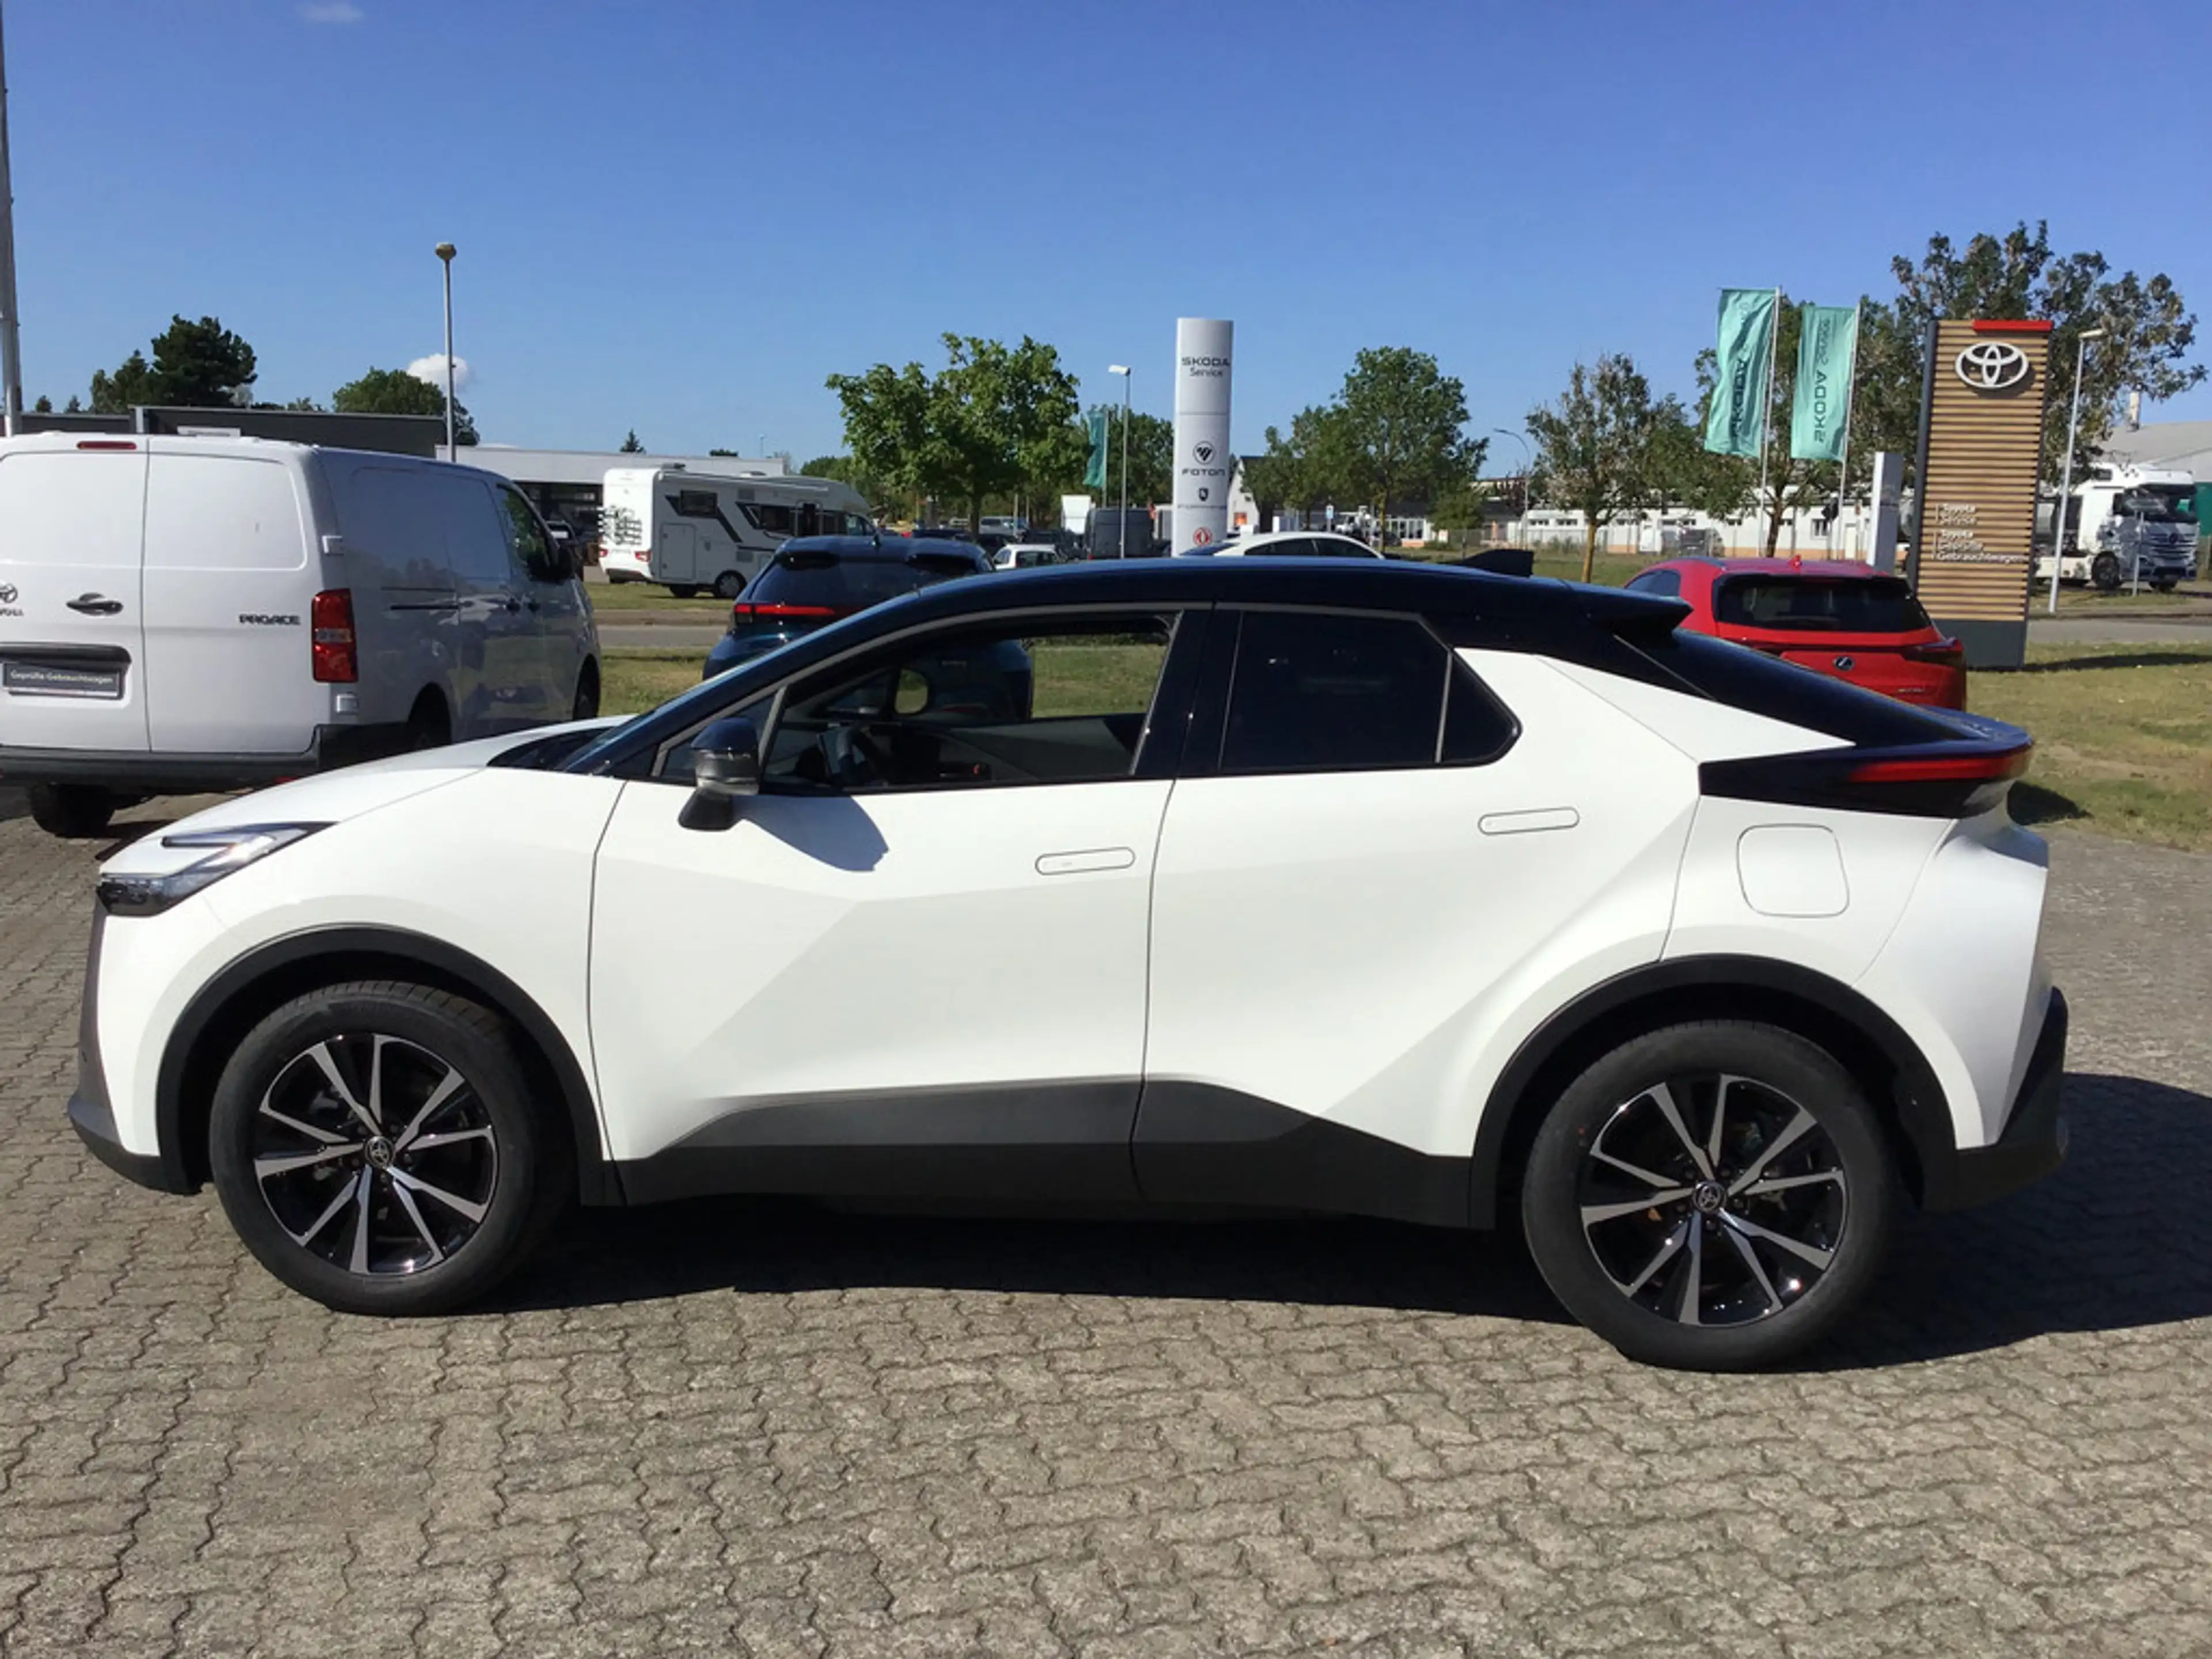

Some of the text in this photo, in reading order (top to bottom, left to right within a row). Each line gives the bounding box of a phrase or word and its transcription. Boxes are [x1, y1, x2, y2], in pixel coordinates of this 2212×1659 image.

[1190, 368, 1223, 377] Service
[1181, 468, 1225, 476] FOTON
[1939, 503, 1976, 516] Toyota
[1940, 529, 1974, 541] Toyota
[238, 614, 301, 625] PROACE
